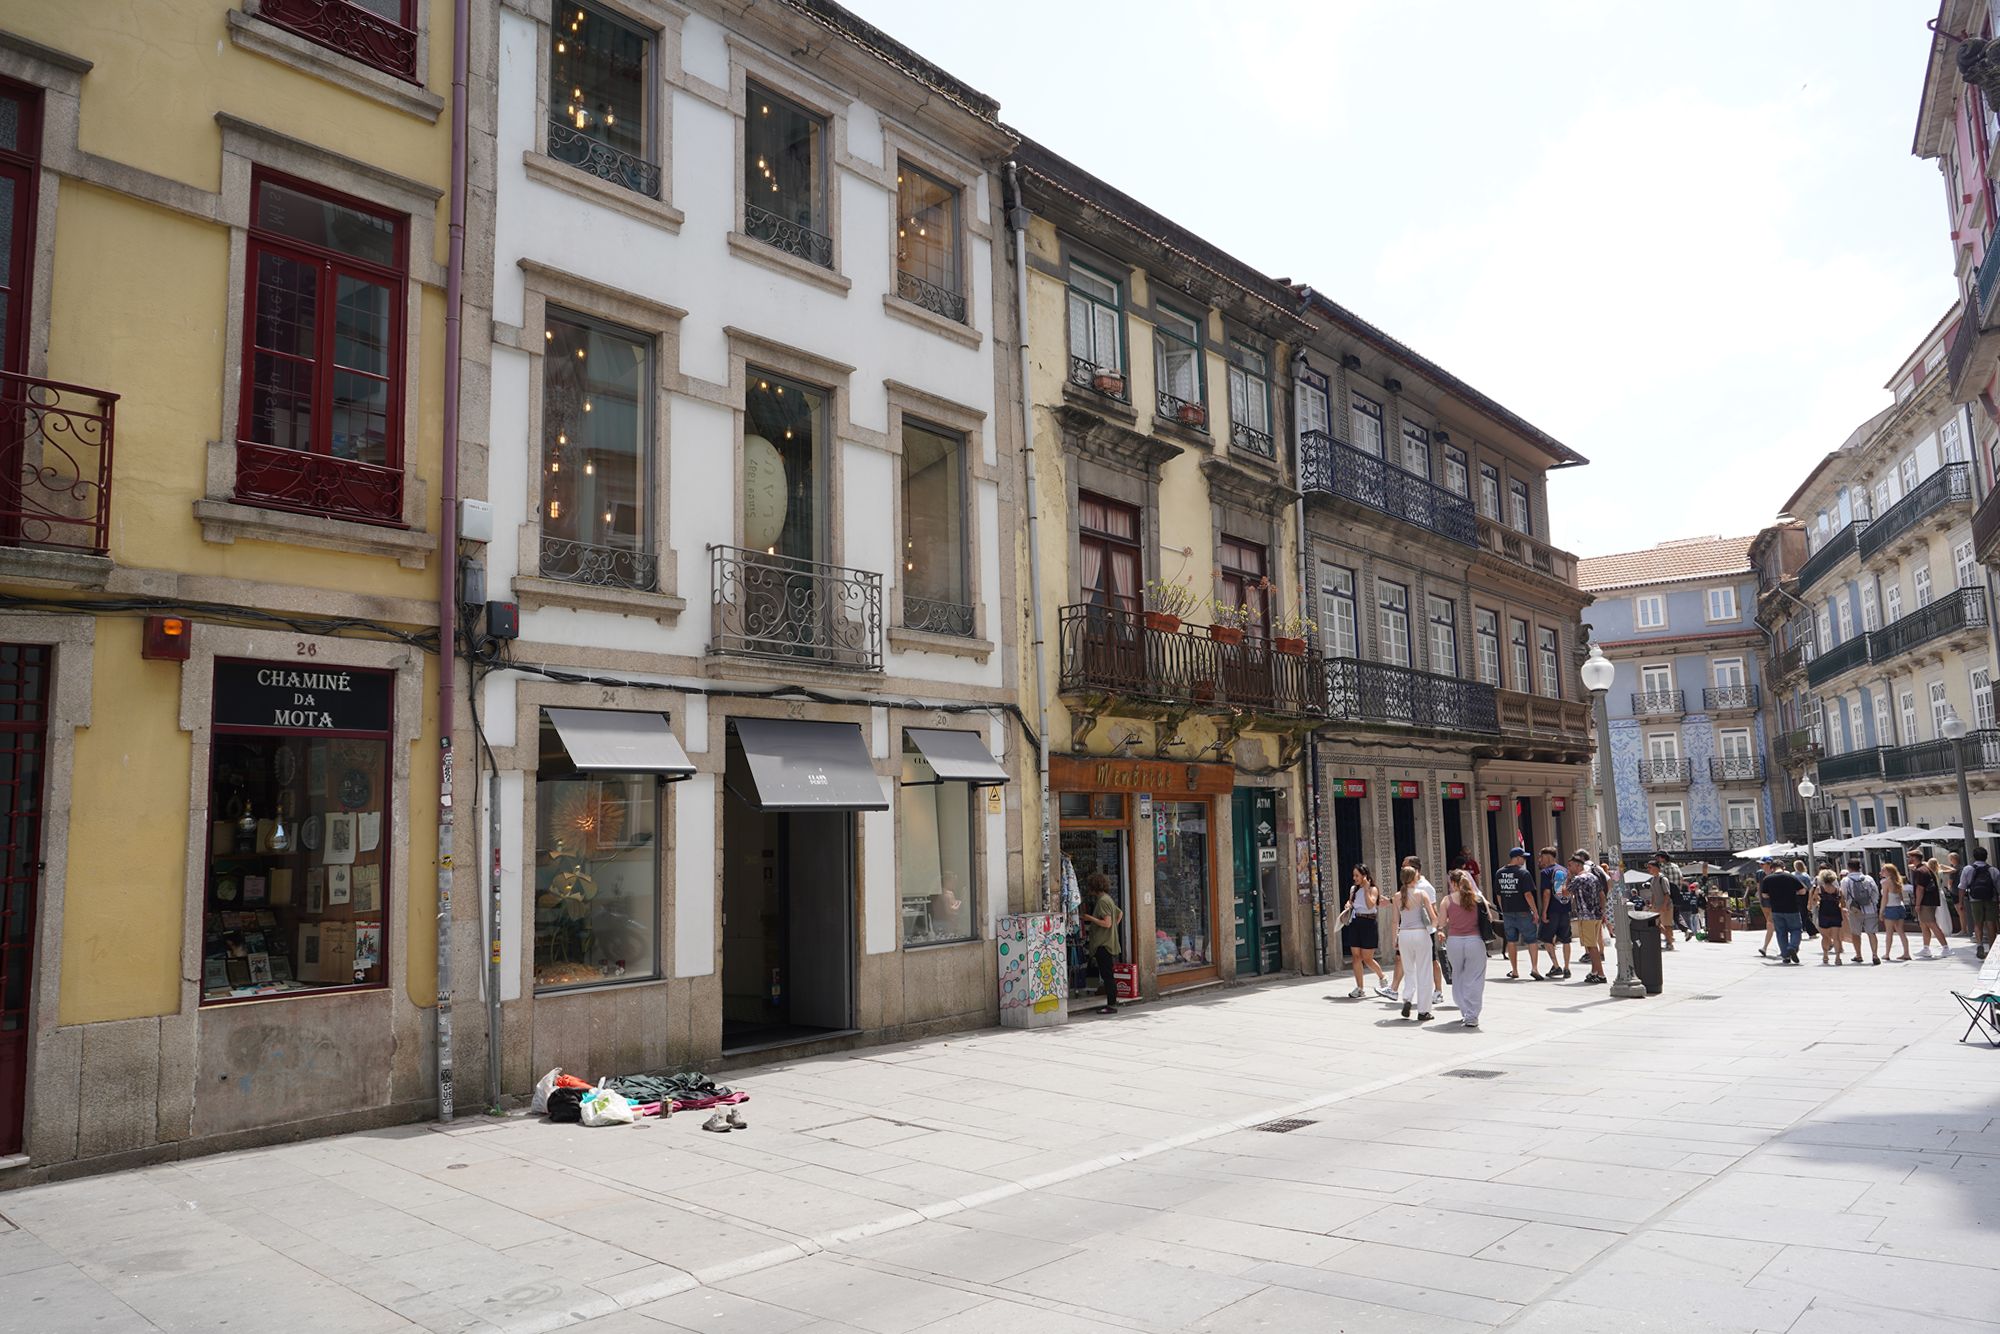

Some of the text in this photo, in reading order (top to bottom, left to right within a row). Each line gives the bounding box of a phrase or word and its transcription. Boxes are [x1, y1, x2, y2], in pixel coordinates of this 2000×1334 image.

[296, 641, 317, 657] 26
[256, 668, 352, 692] CHAMINÉ
[293, 693, 316, 706] DA
[601, 690, 617, 704] 24
[273, 709, 334, 728] MOTA
[936, 715, 947, 726] 20
[1256, 798, 1271, 809] ATM
[1261, 851, 1275, 859] ATM
